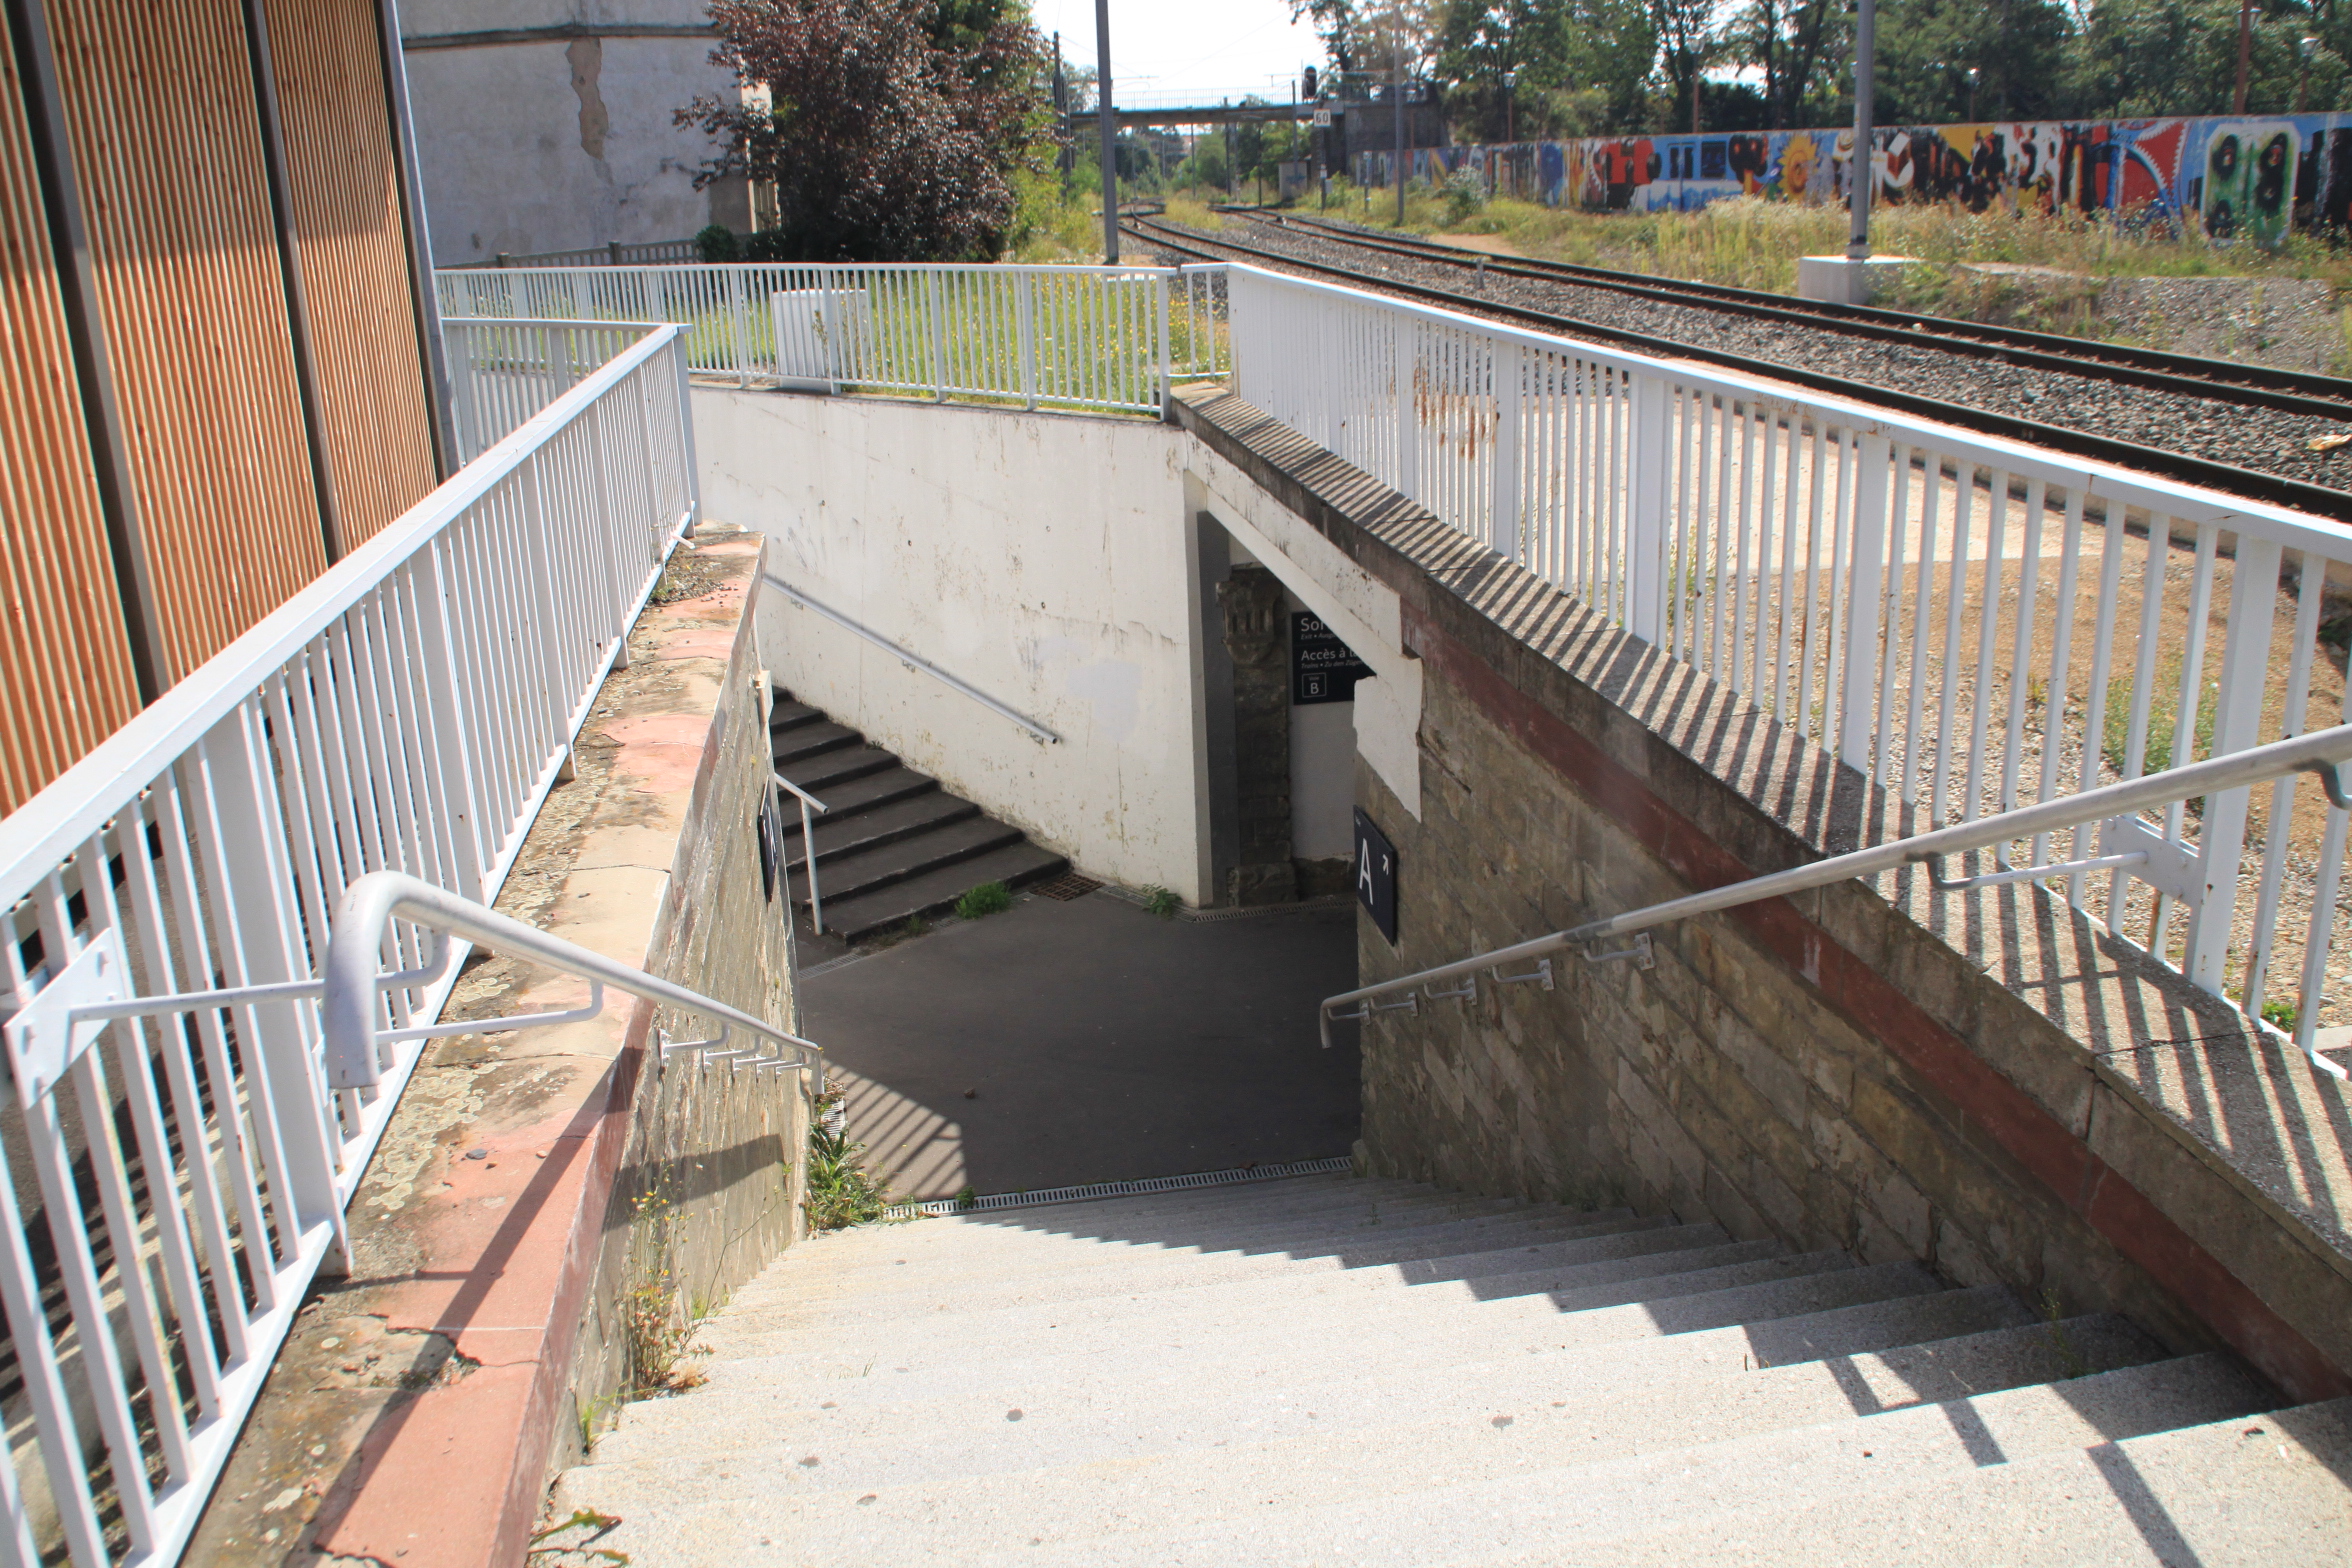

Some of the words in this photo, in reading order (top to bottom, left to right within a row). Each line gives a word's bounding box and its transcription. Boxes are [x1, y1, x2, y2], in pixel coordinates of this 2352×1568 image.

[1315, 112, 1329, 123] 60
[1301, 648, 1336, 661] Accès
[1339, 647, 1346, 658] à
[1310, 682, 1319, 695] B
[1358, 838, 1373, 905] A
